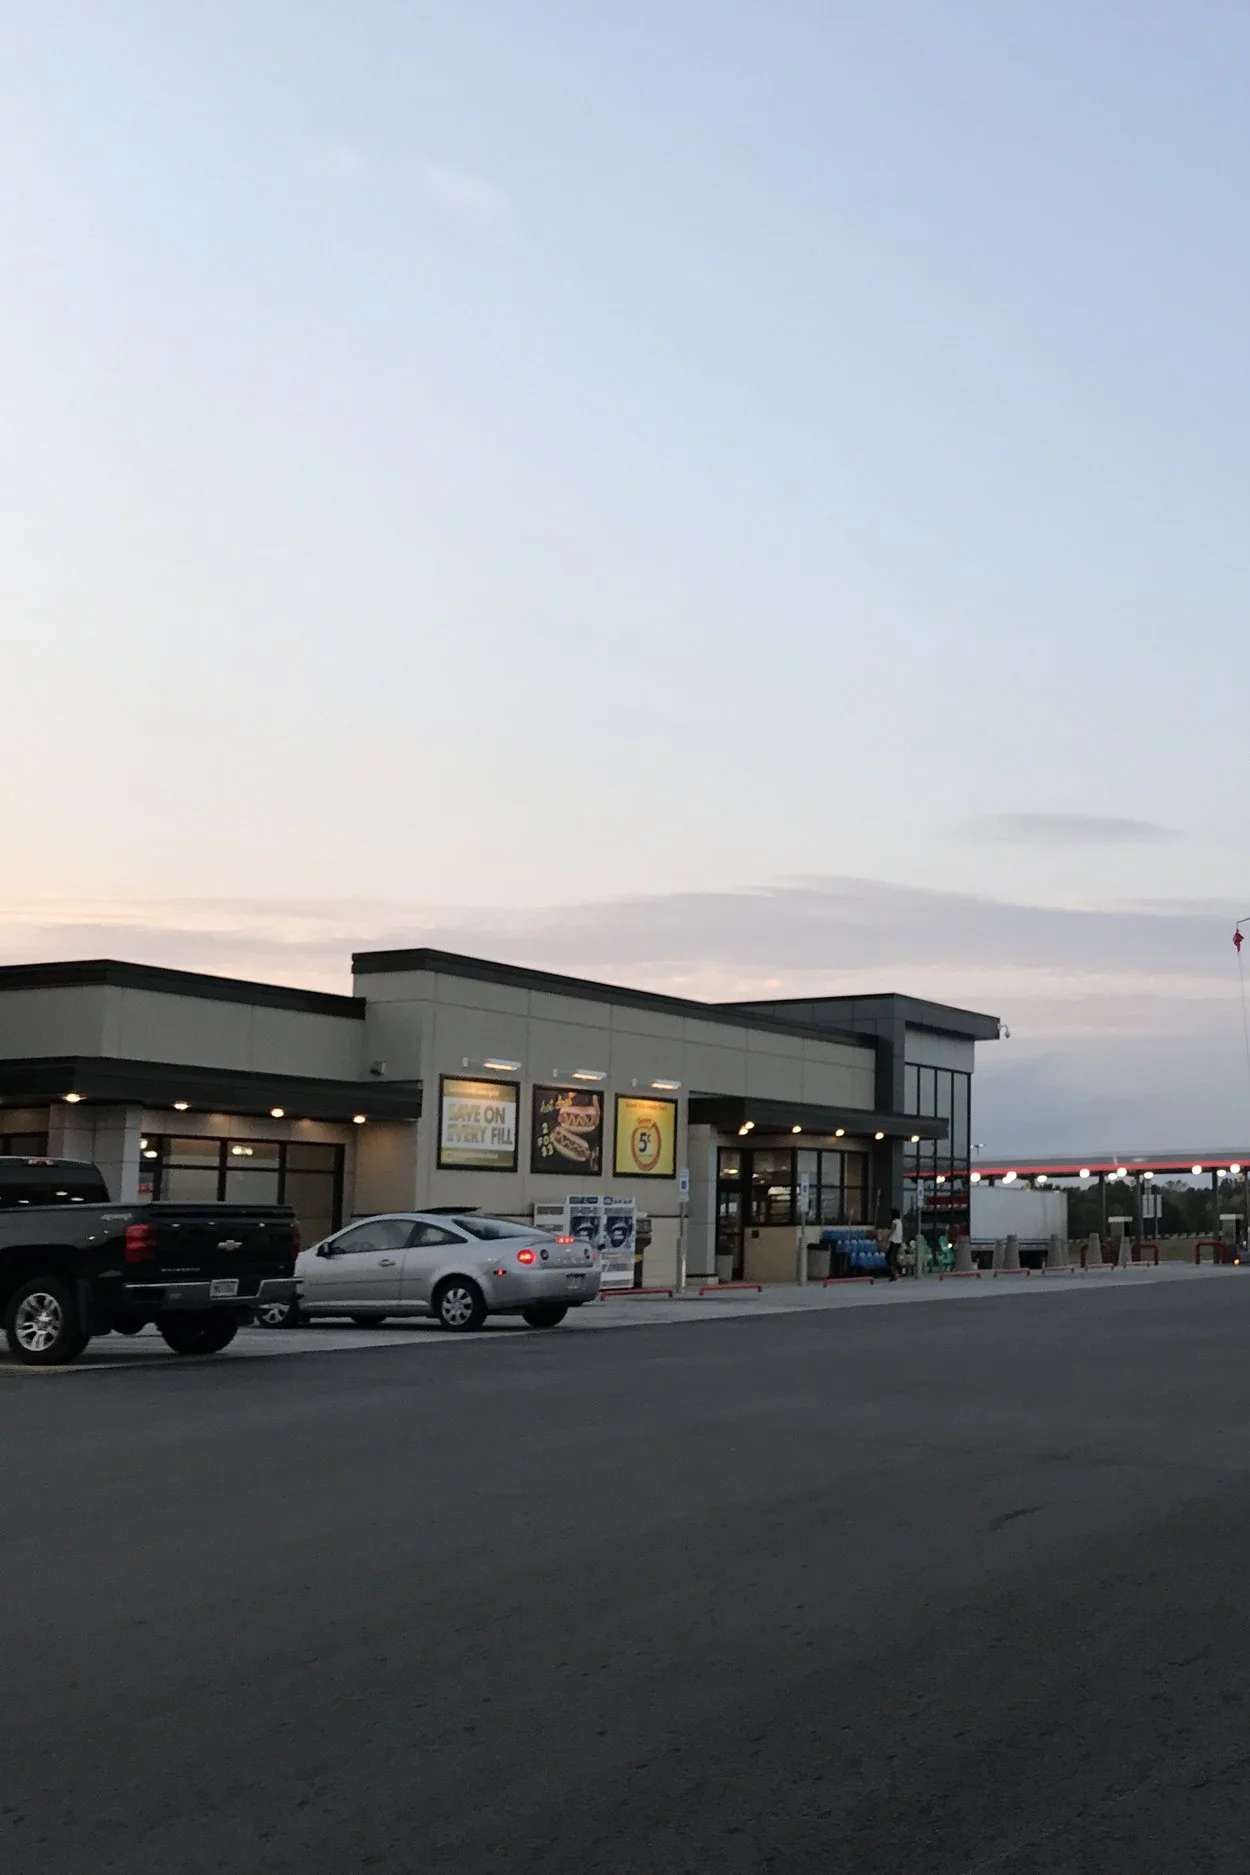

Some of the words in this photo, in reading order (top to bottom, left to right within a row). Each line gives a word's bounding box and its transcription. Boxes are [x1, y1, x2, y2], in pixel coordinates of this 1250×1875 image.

[447, 1103, 482, 1123] SAVE
[483, 1105, 506, 1125] ON
[447, 1124, 488, 1143] EVERY
[491, 1126, 513, 1145] FILL
